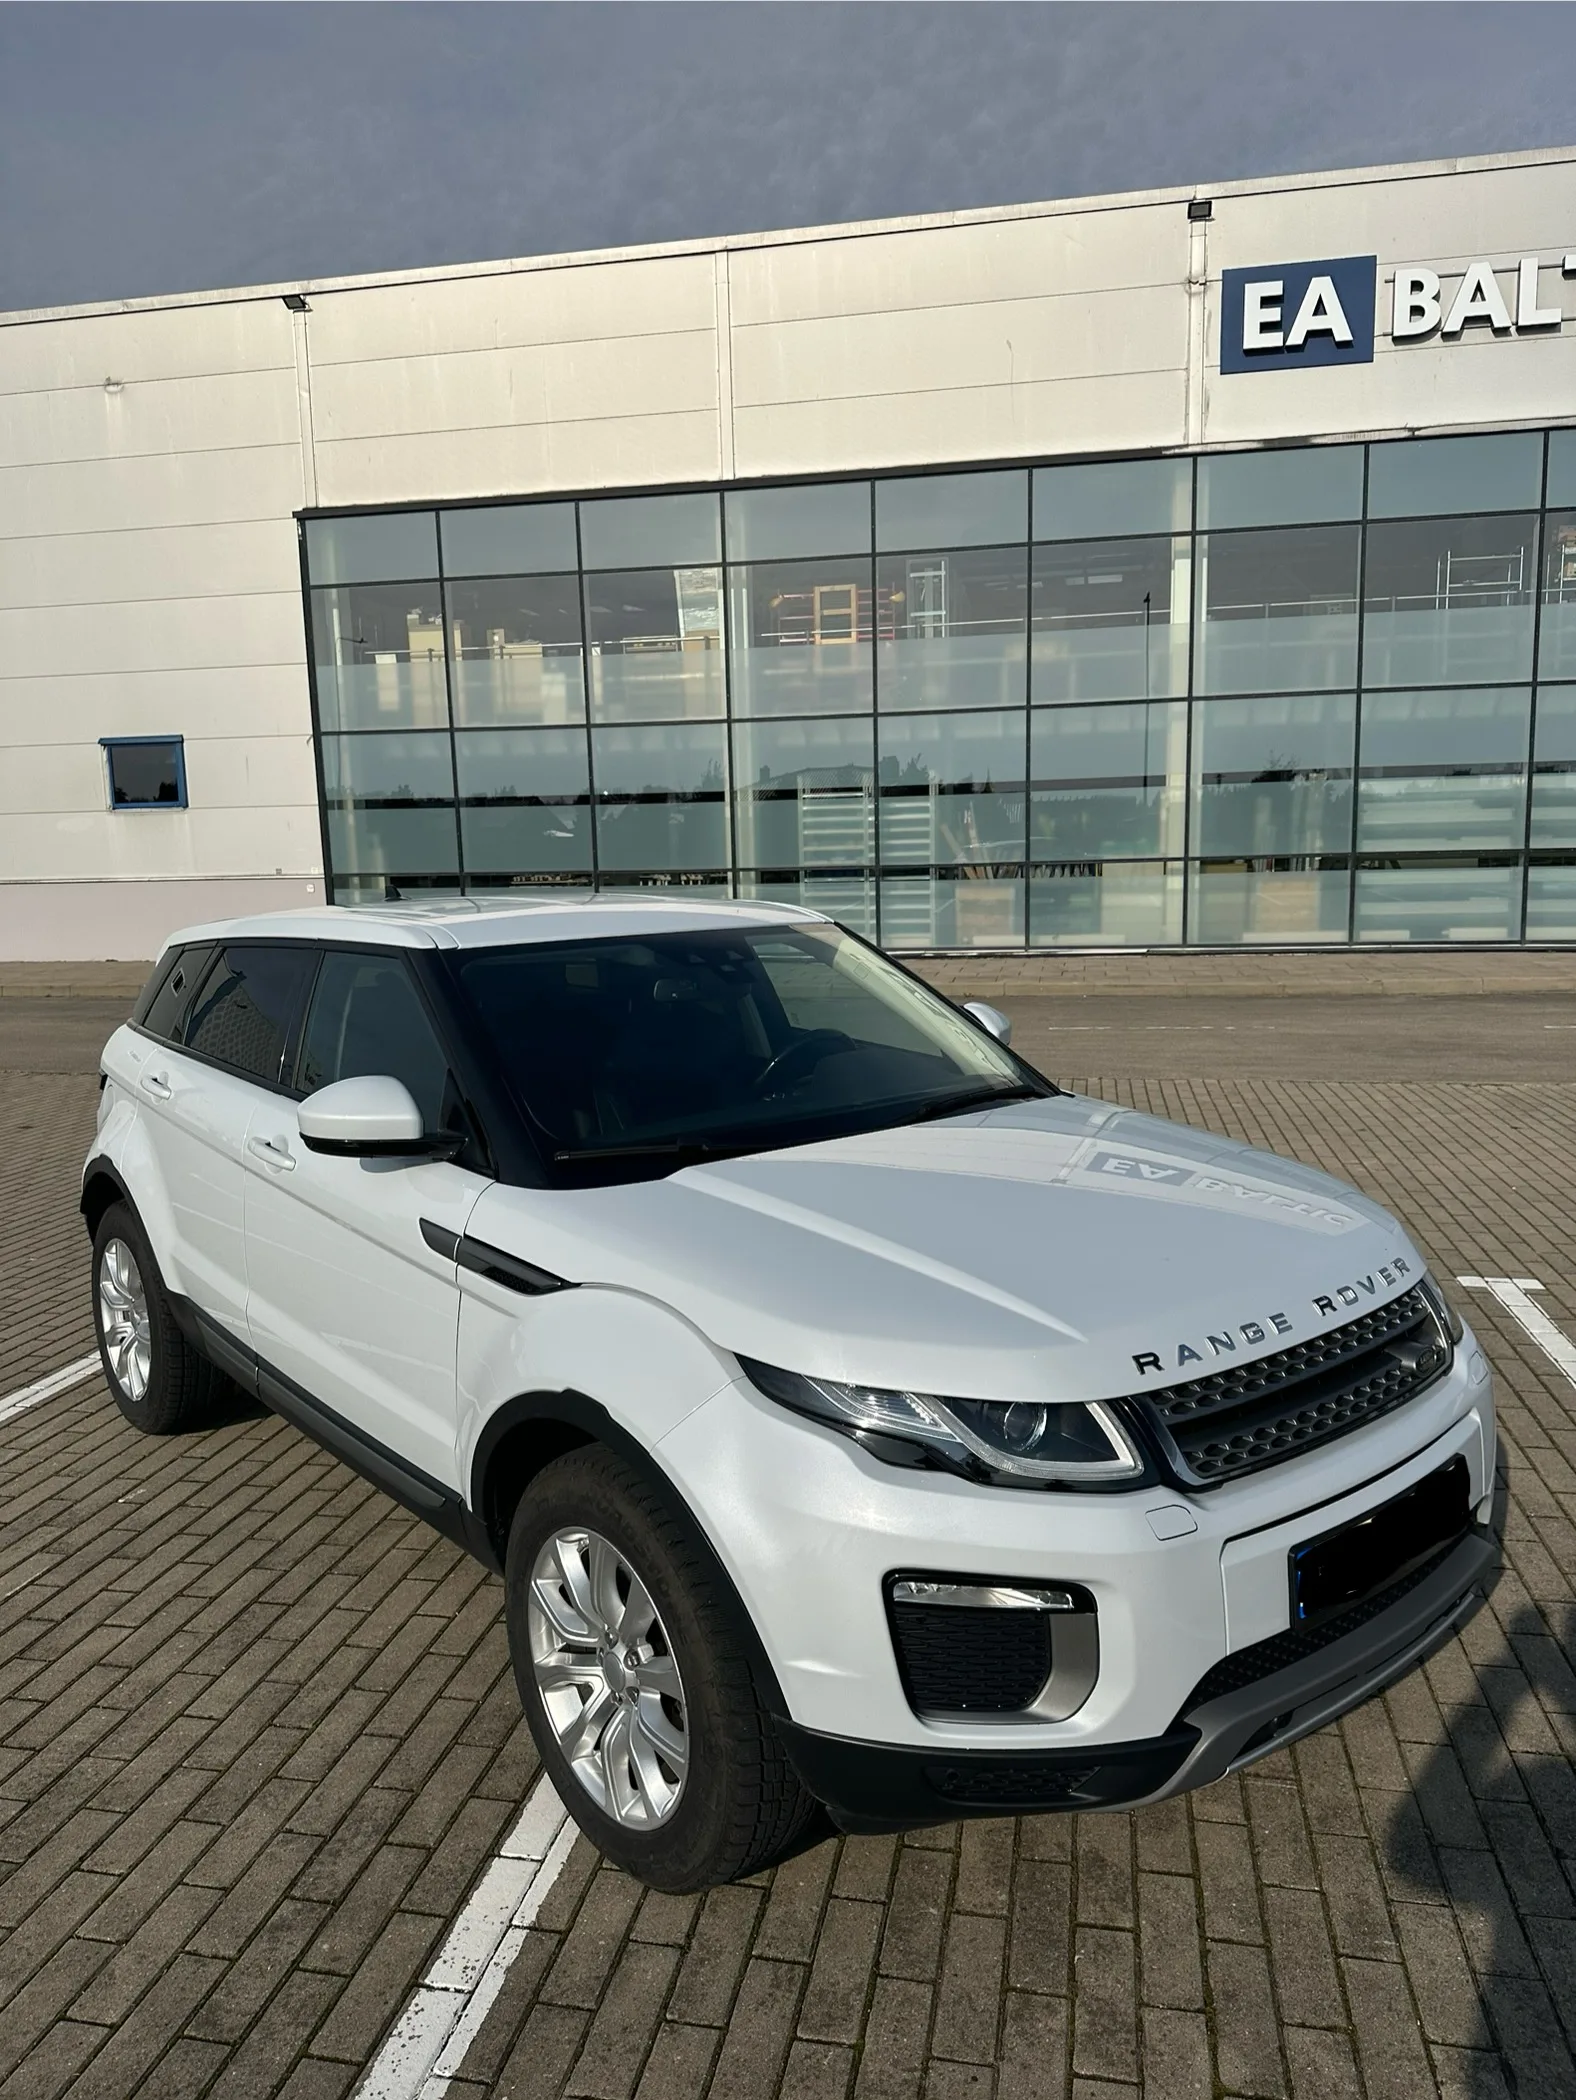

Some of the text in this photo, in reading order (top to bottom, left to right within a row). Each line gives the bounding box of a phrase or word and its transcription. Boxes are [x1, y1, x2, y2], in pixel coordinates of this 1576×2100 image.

[1243, 254, 1576, 351] EA BAL
[1131, 1256, 1412, 1376] RANGE ROVER
